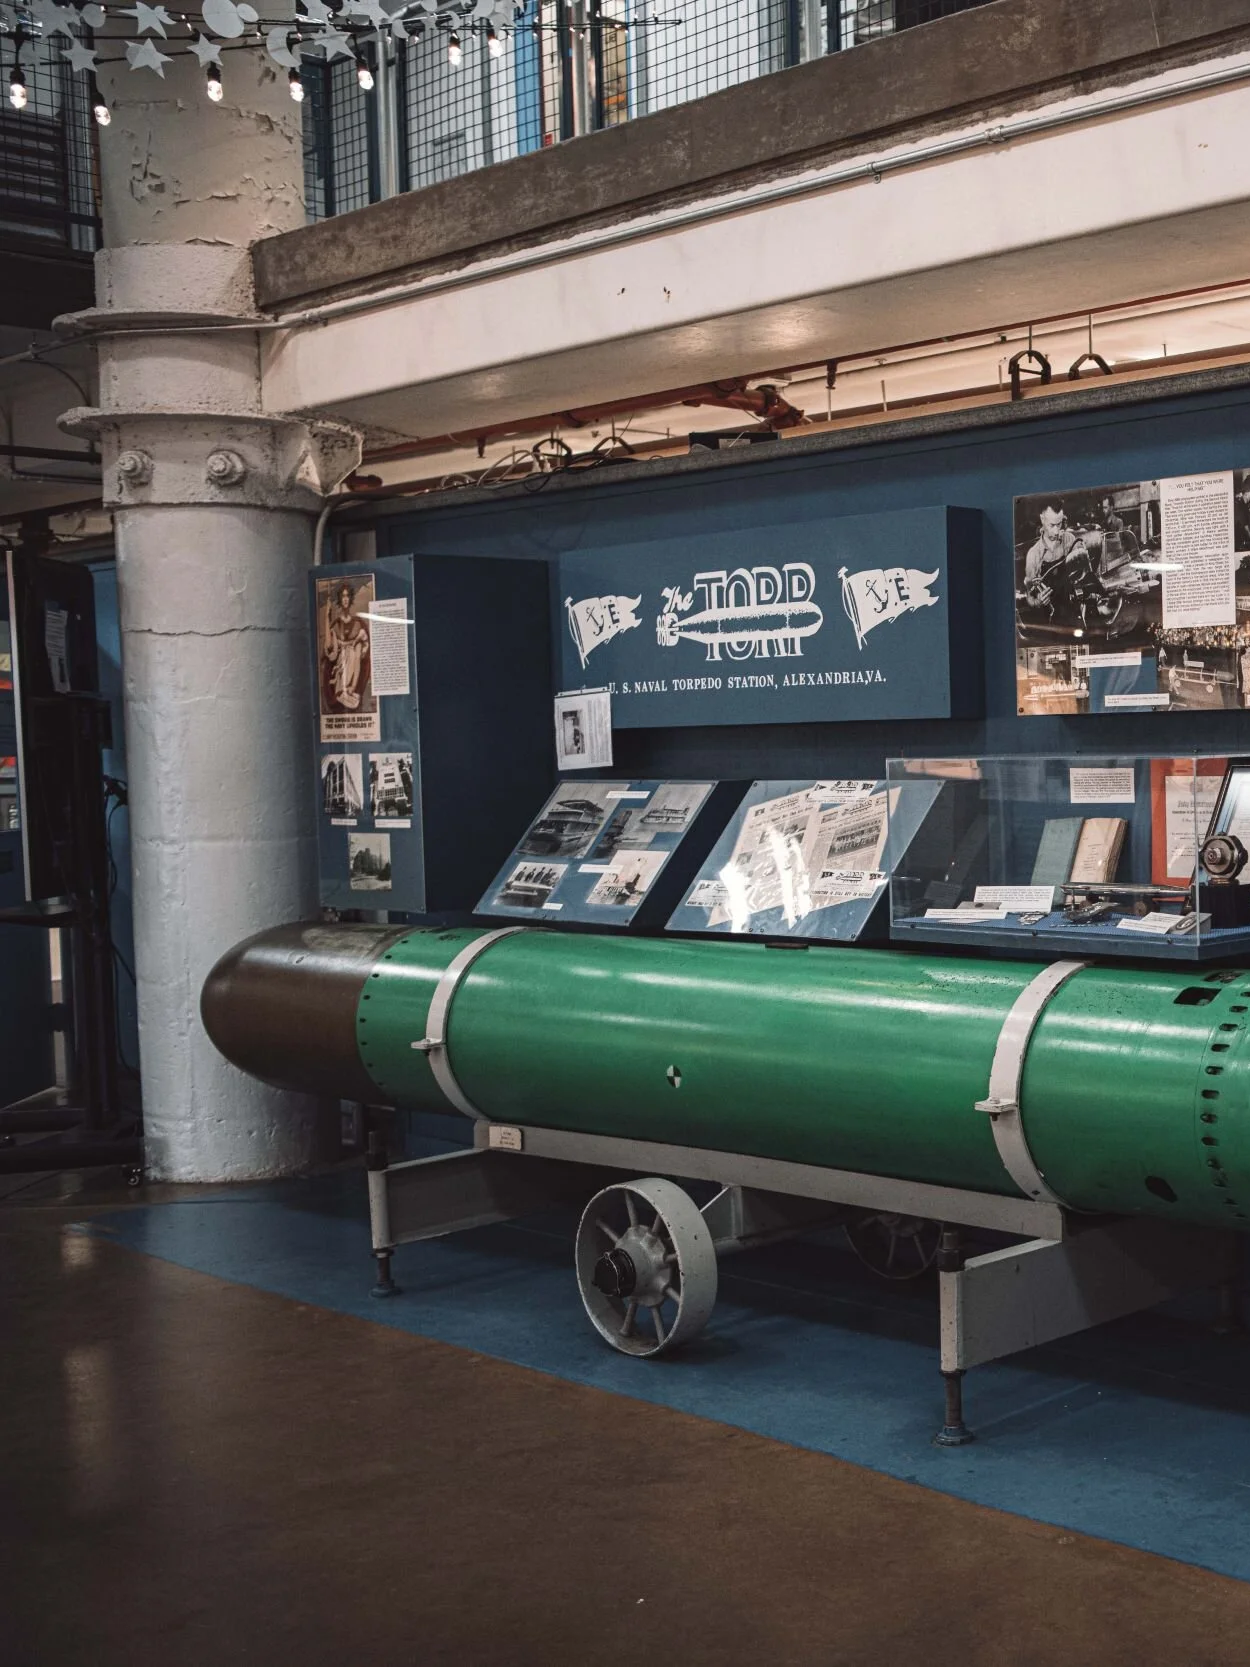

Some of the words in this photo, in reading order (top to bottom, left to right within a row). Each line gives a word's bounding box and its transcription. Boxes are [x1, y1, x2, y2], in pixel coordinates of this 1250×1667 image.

[661, 586, 695, 614] The
[622, 682, 632, 694] S.
[634, 680, 668, 693] NAVAL
[672, 677, 722, 691] TORPEDO
[727, 674, 779, 690] STATION,
